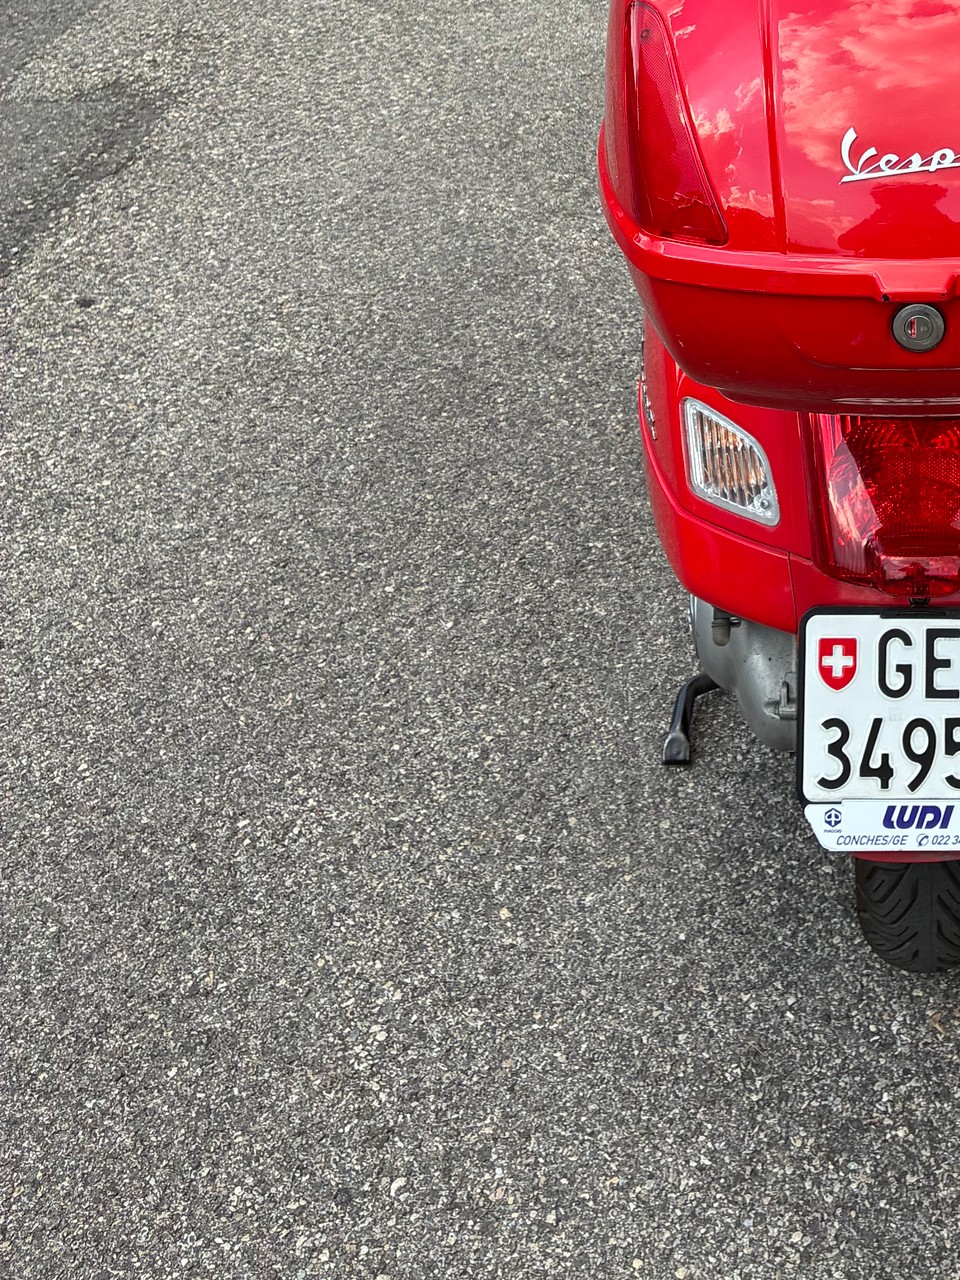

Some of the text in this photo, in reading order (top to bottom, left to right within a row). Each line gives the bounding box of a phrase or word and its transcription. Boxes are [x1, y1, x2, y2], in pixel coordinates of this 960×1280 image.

[878, 628, 960, 699] GE
[882, 805, 955, 830] LUDI
[836, 835, 908, 846] CONCHES/GE
[931, 835, 950, 845] 022
